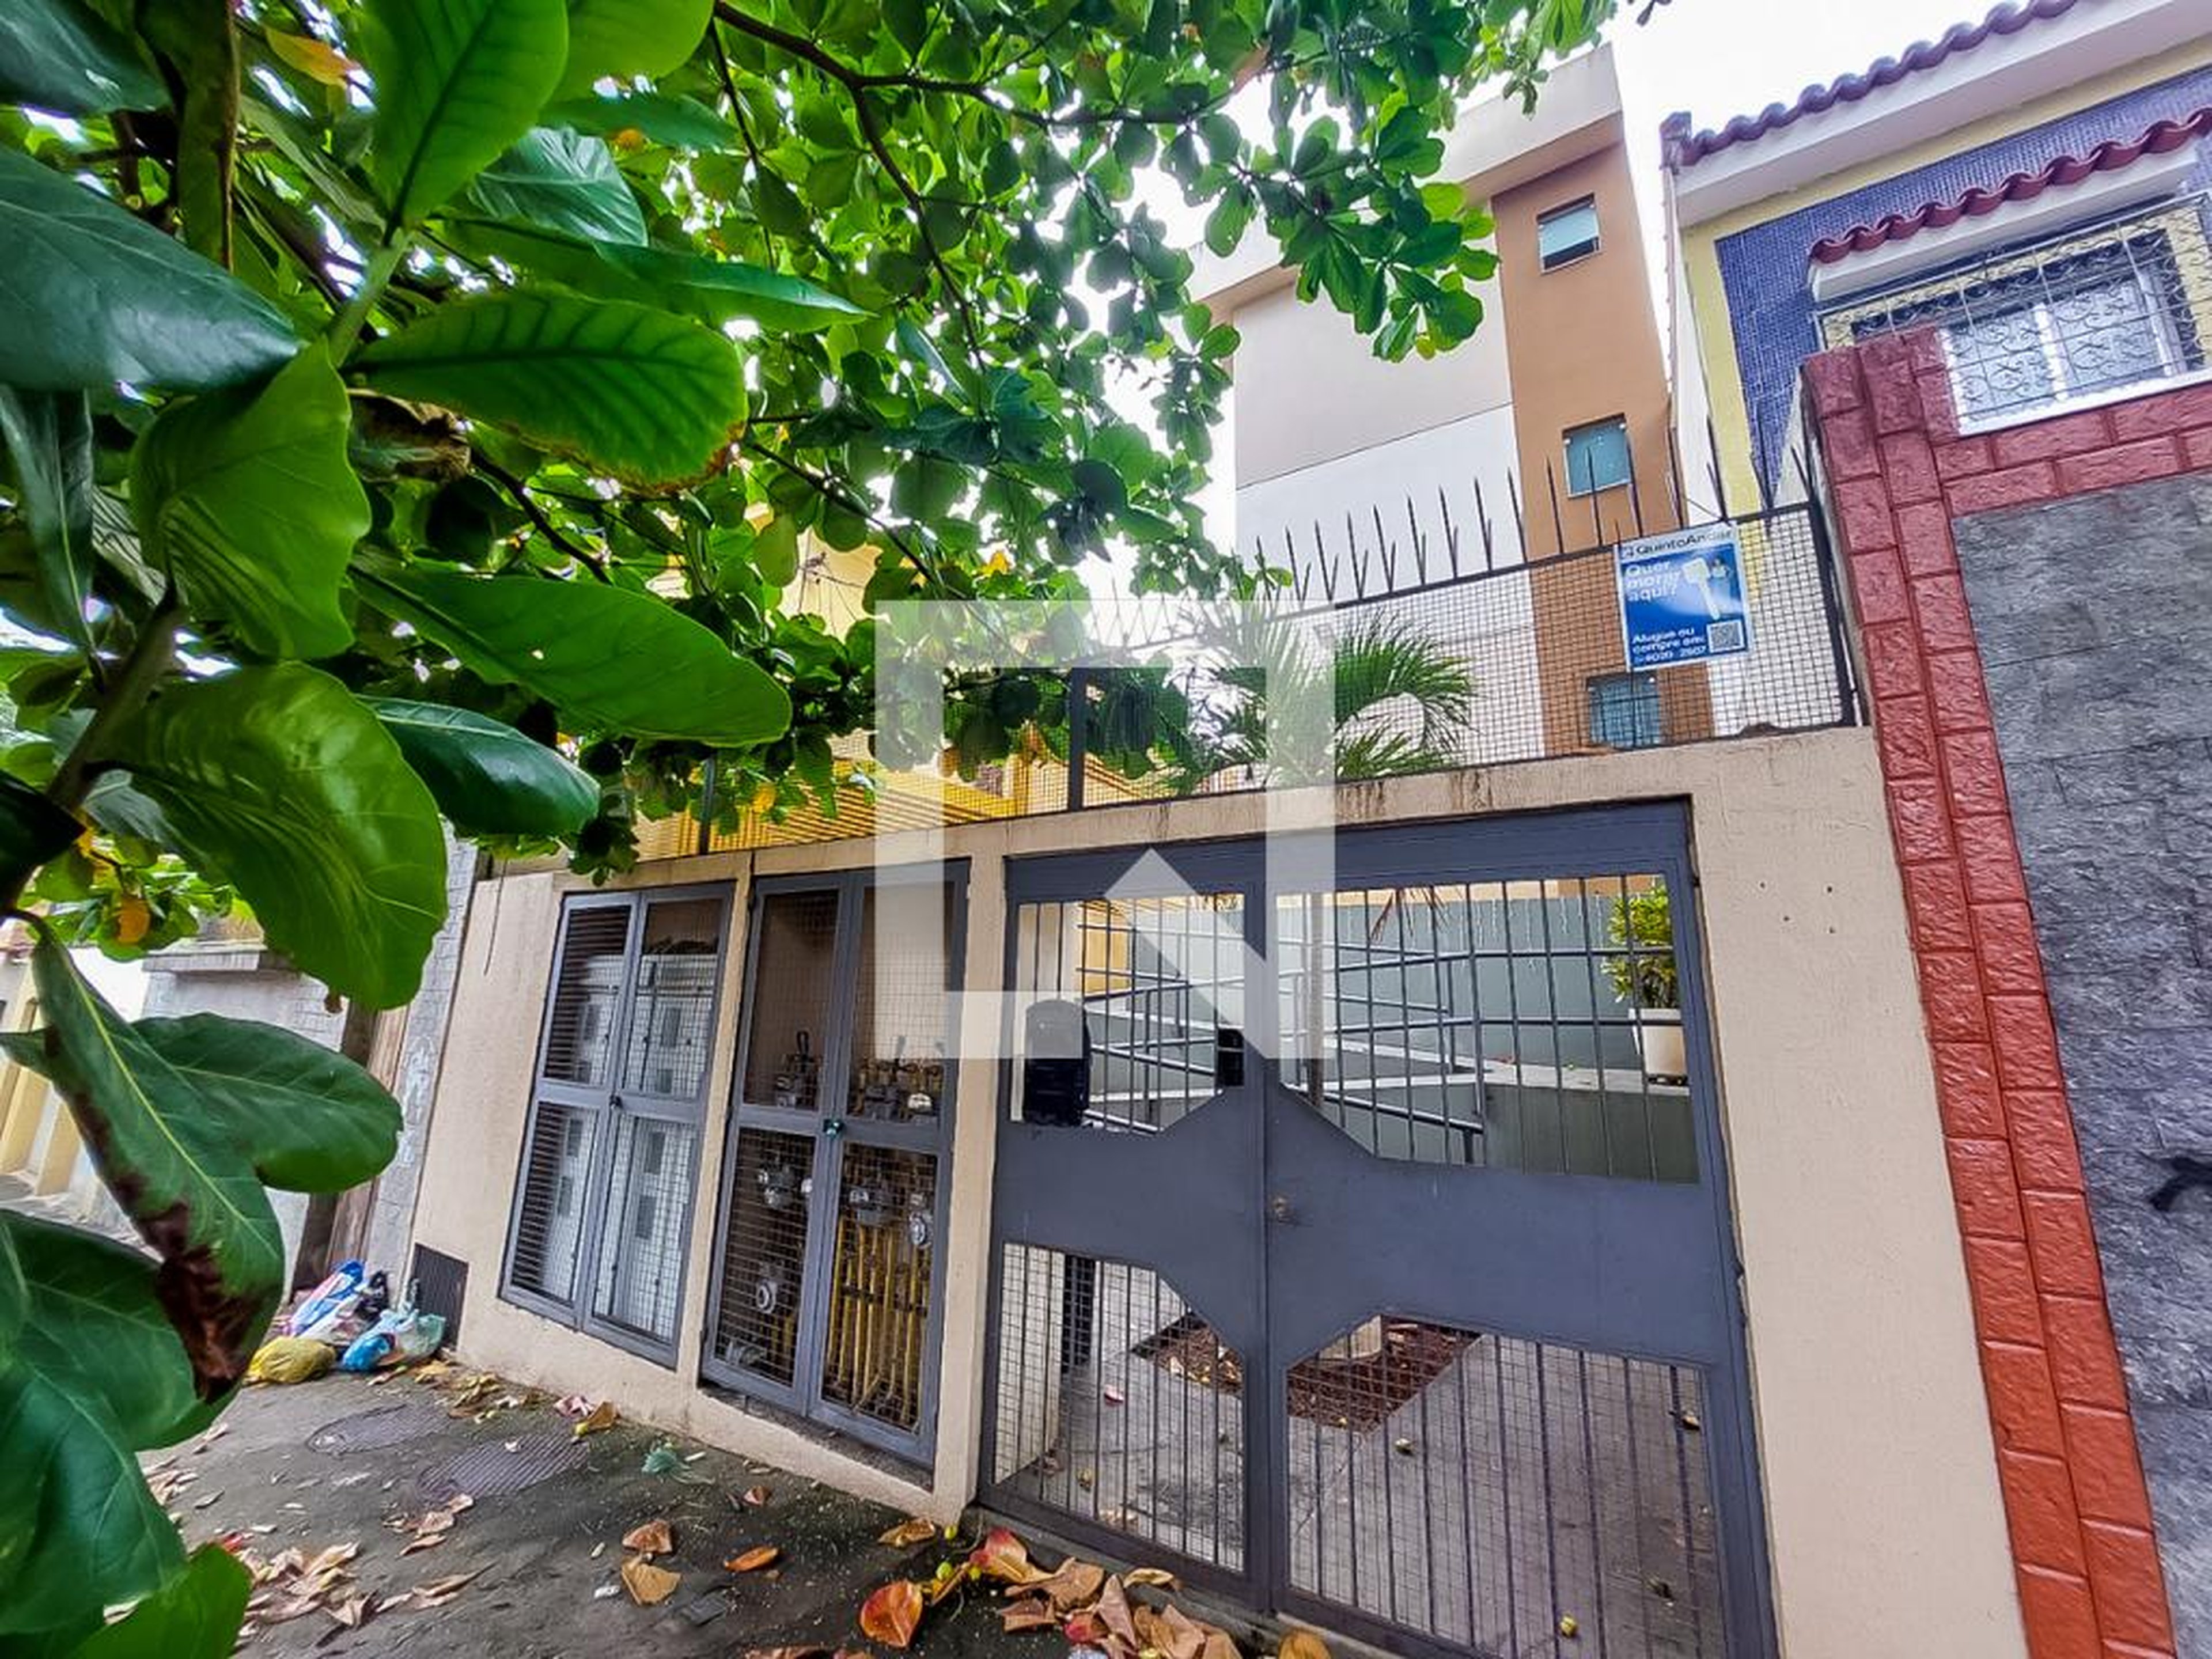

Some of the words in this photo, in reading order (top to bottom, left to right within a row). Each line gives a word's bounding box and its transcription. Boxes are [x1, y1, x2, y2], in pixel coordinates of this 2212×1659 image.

[1626, 560, 1671, 576] Quer
[1627, 570, 1681, 589] morar
[1628, 583, 1677, 603] aqui?
[1678, 627, 1694, 638] ou
